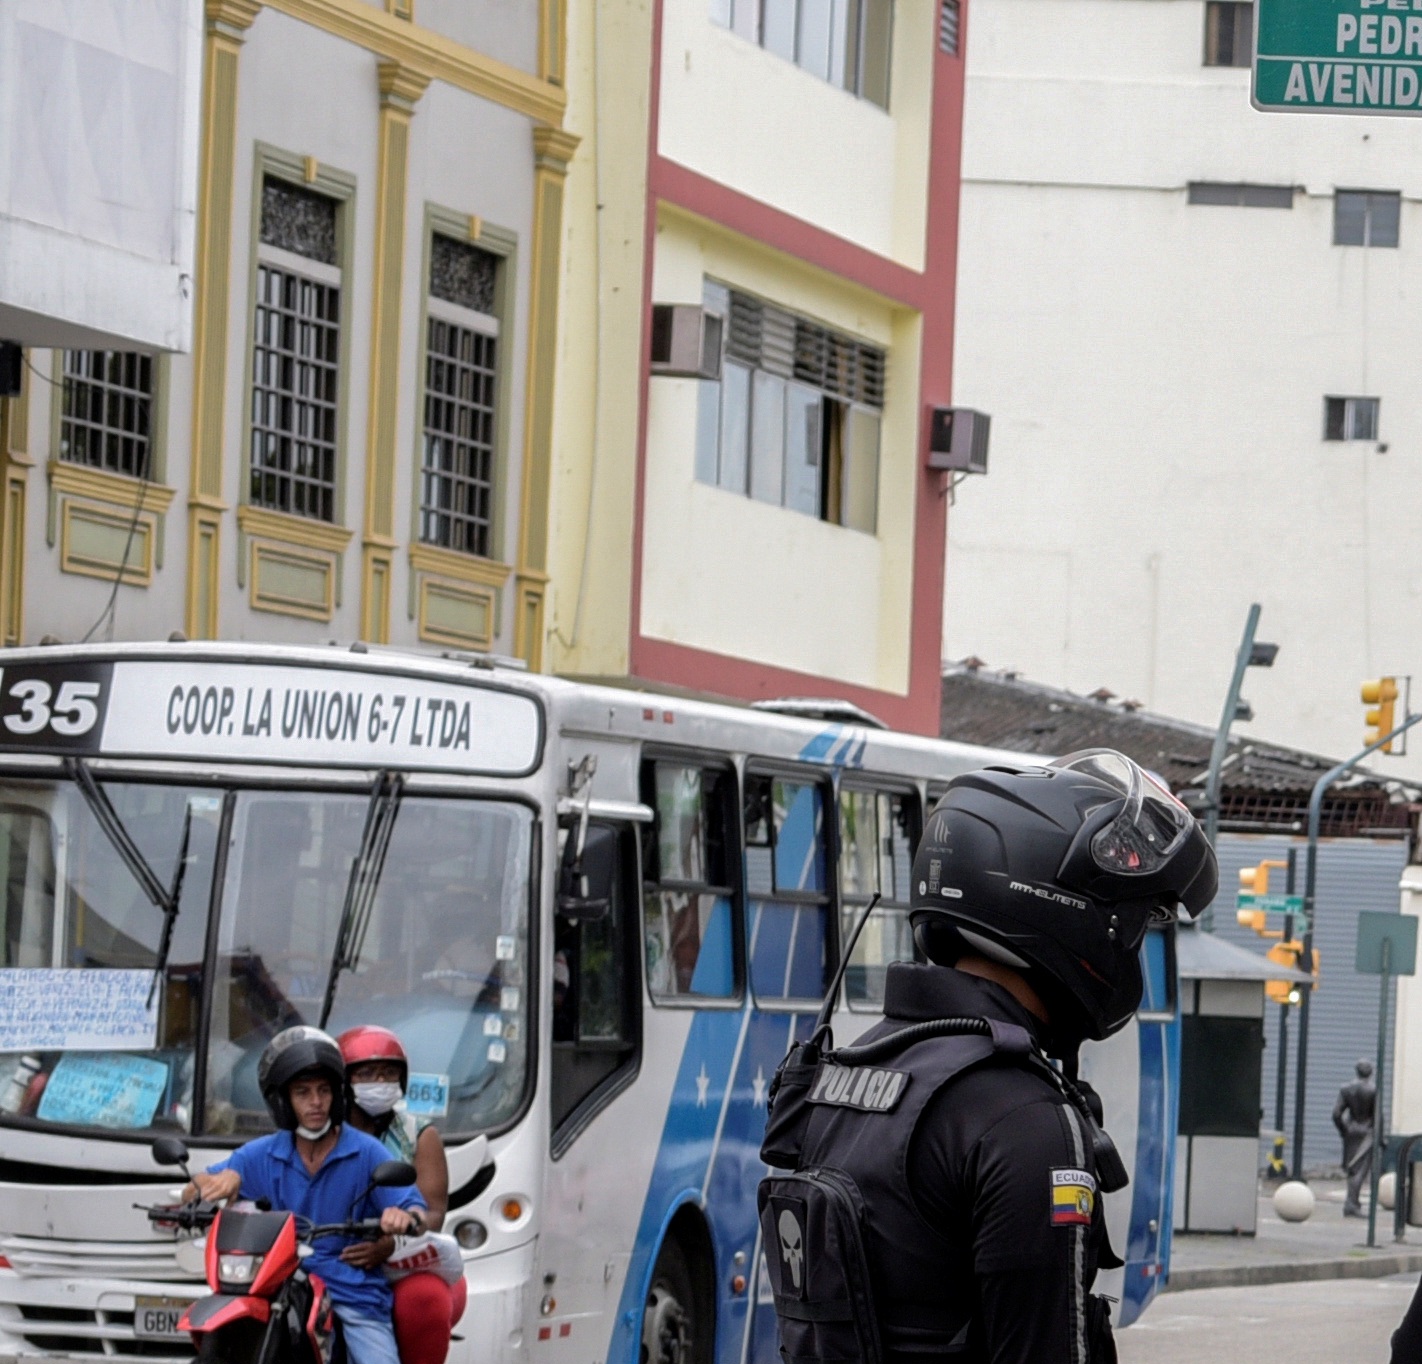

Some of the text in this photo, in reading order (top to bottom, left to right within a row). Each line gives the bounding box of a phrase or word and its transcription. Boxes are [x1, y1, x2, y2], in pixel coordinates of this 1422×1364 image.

[3, 680, 472, 750] 35 COOP. LA UNION 6-7 LTDA
[811, 1063, 904, 1109] POLICIA
